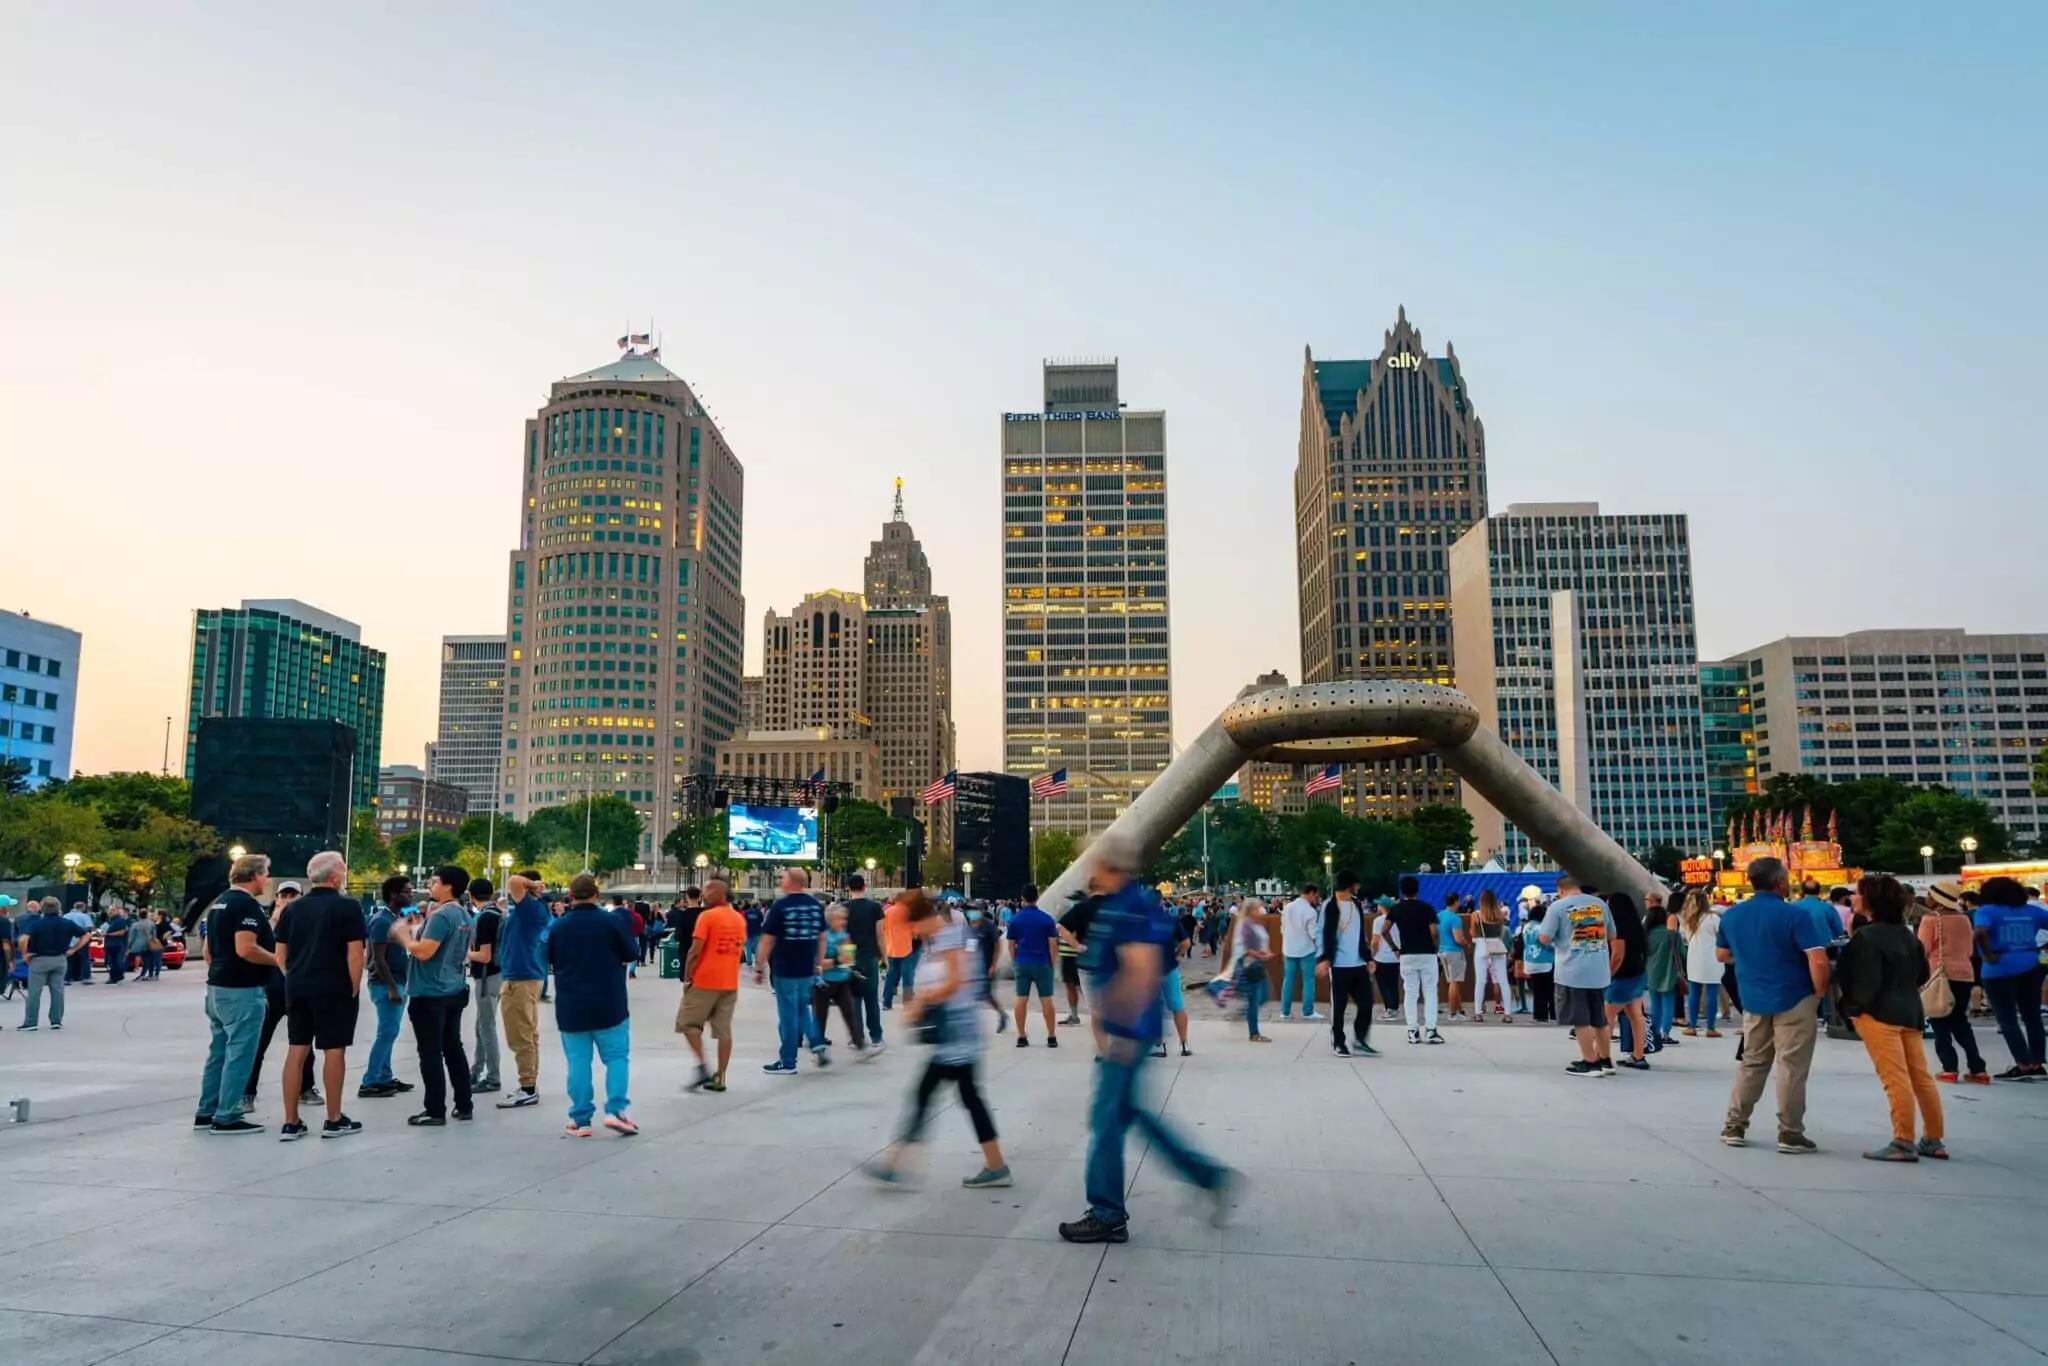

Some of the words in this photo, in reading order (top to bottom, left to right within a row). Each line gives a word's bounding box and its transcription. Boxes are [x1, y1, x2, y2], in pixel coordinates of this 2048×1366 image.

[1387, 352, 1422, 372] ally
[1005, 412, 1040, 421] FIFTH
[1045, 411, 1082, 421] THIRD
[1086, 410, 1121, 420] BANK
[1680, 859, 1713, 872] MOTOWN
[1684, 871, 1711, 884] BISTRO
